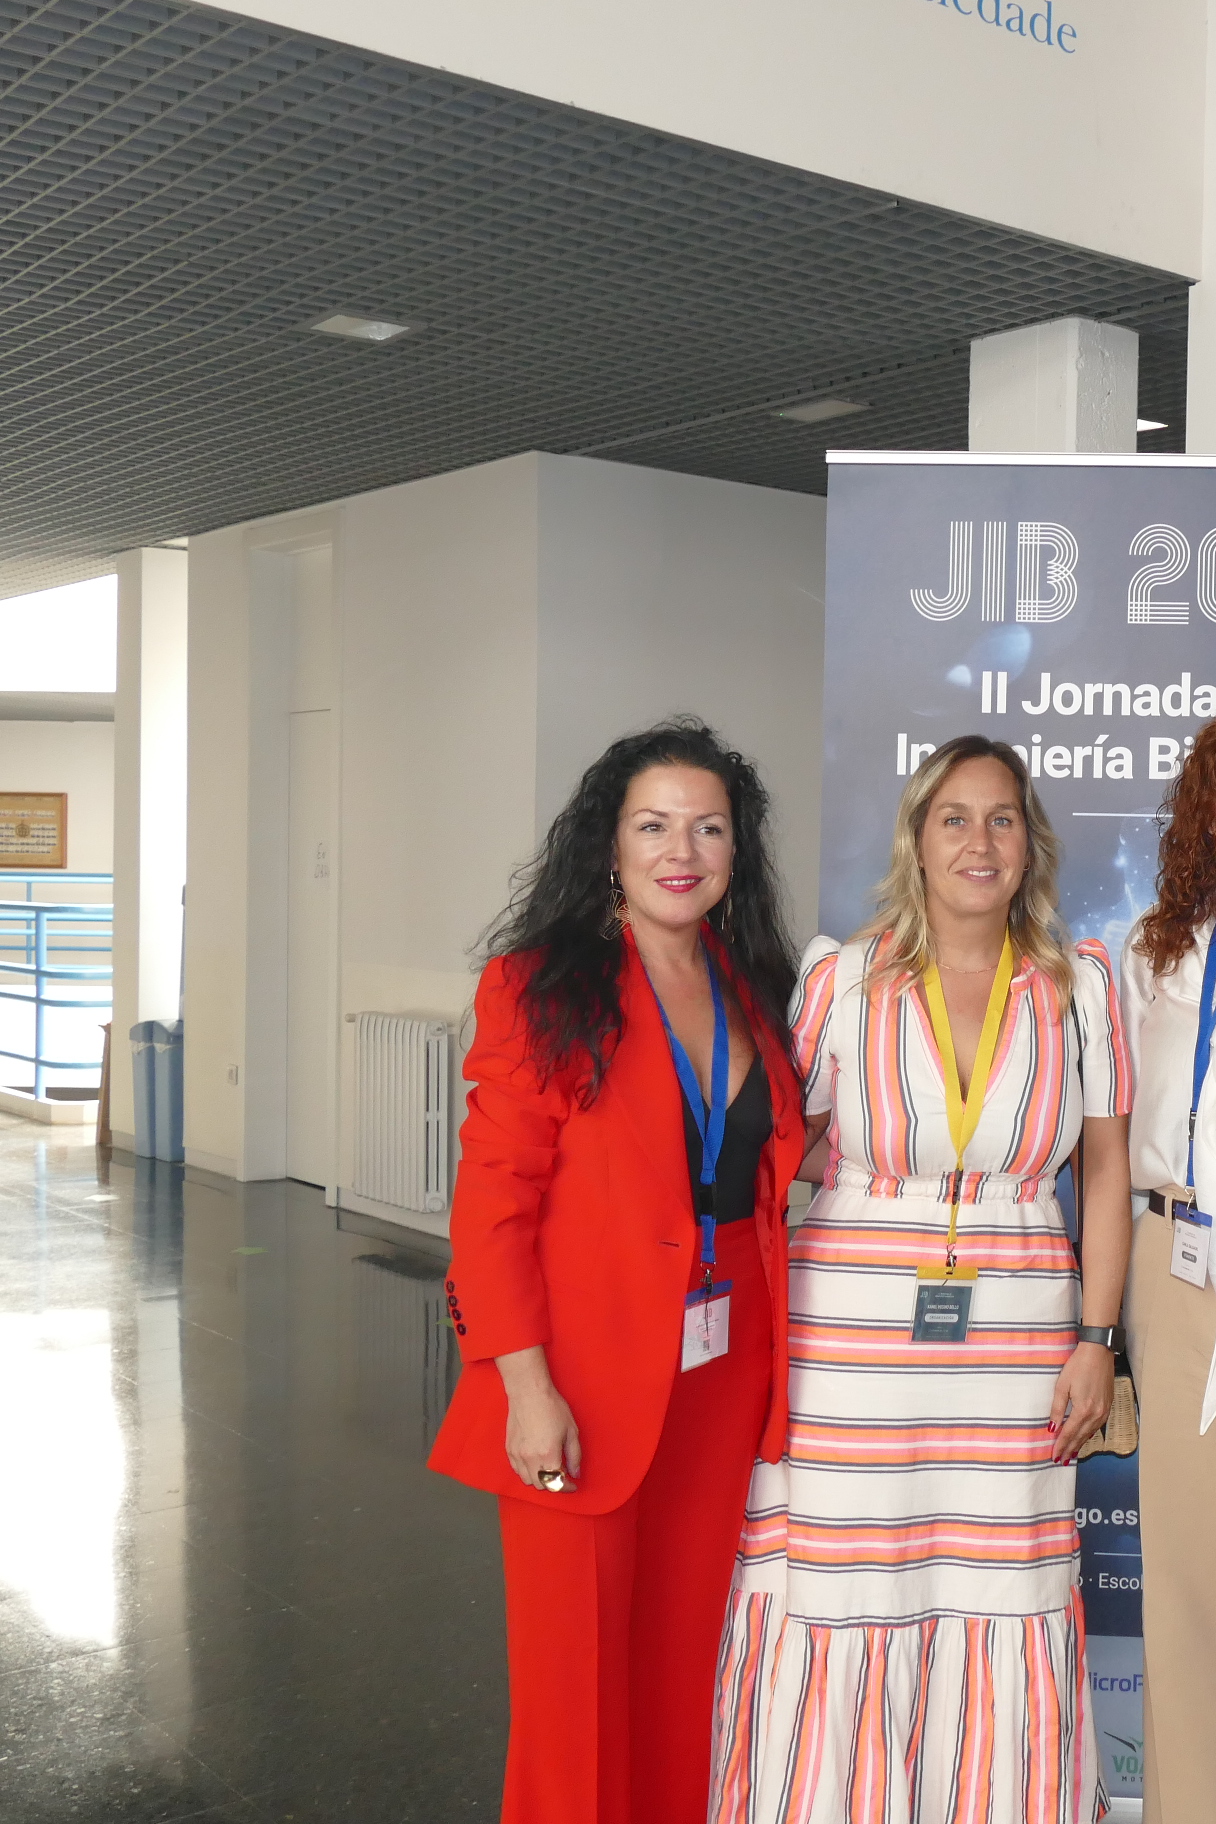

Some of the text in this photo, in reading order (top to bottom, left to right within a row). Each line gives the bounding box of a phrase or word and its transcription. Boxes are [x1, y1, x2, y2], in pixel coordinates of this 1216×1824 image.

[910, 521, 1079, 622] JIB
[980, 670, 1008, 715] II
[896, 732, 1134, 780] Iniería
